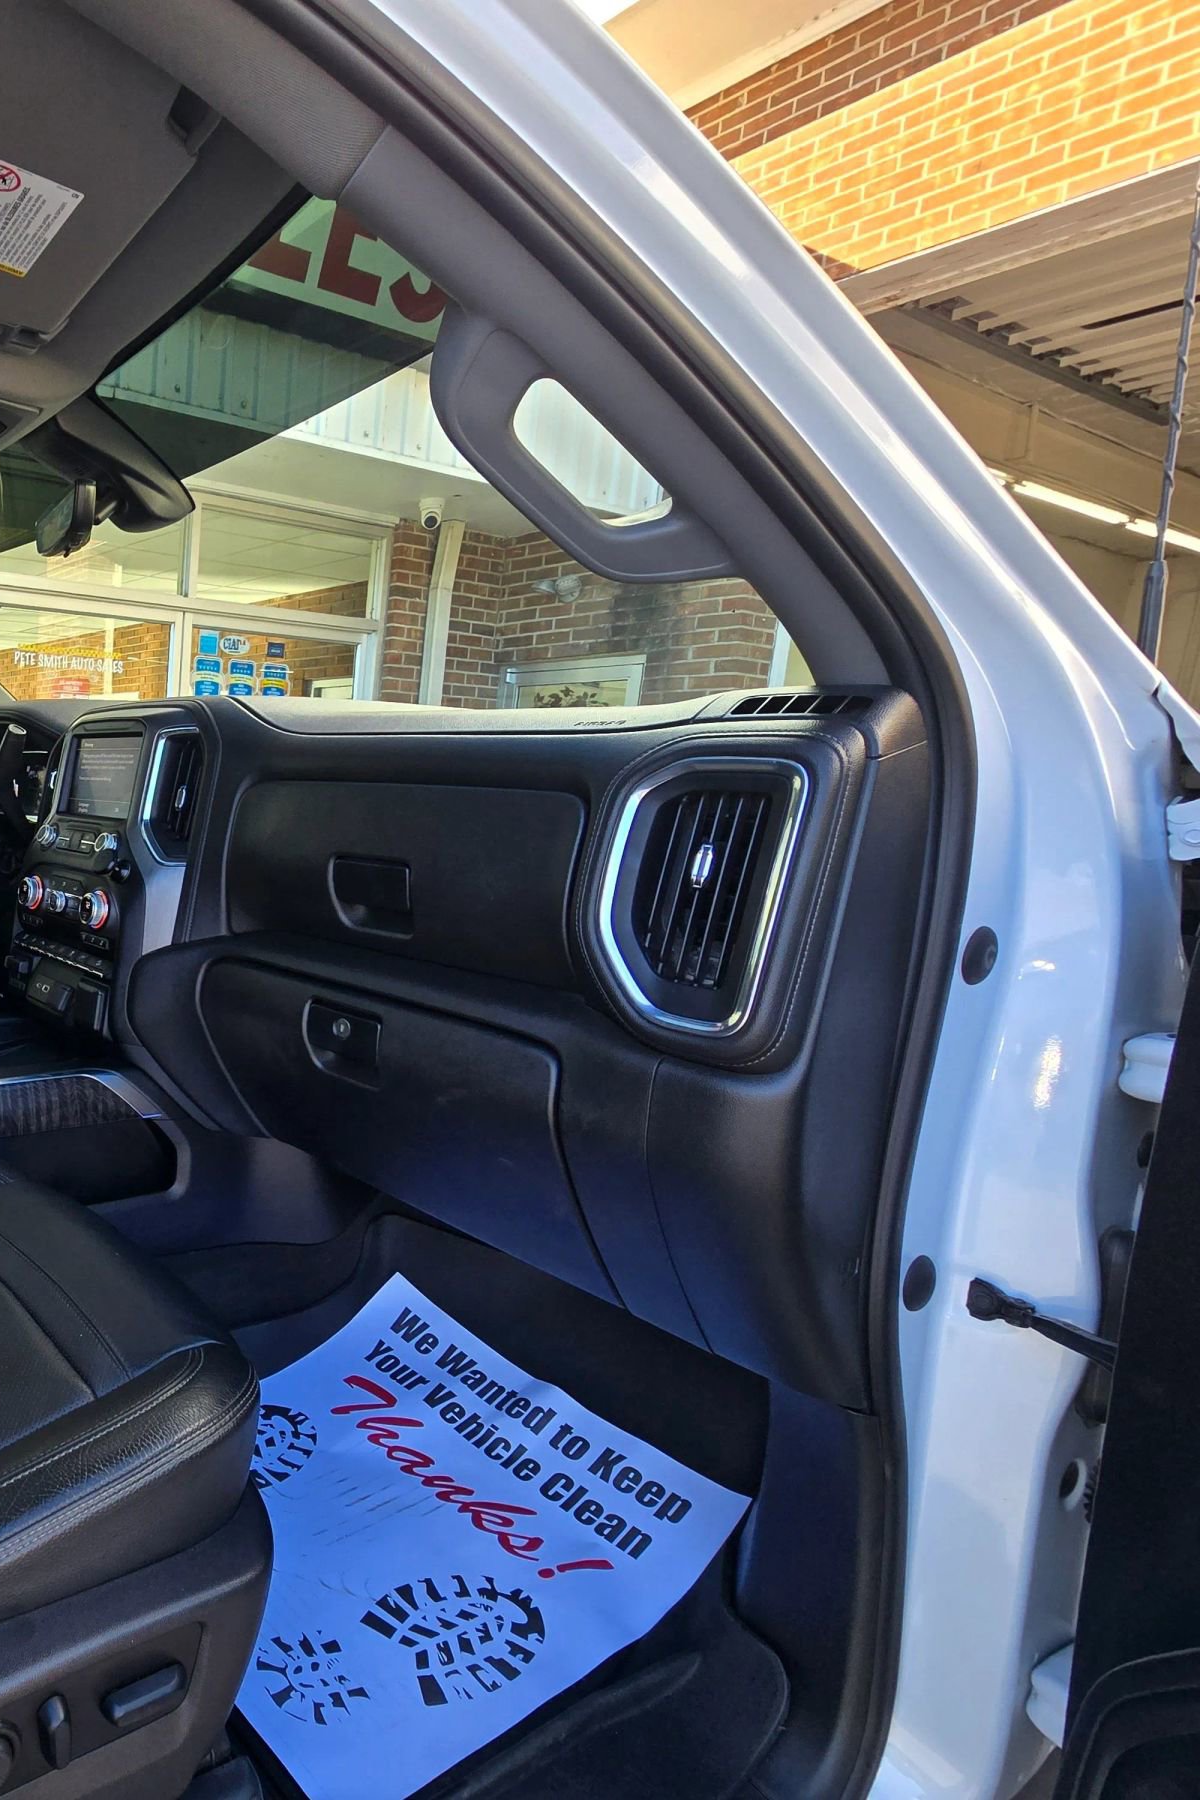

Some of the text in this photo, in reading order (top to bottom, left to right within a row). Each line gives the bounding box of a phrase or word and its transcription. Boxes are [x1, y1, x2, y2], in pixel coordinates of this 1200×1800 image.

[14, 651, 123, 674] PETE SMITH AUTO SAES
[330, 1375, 615, 1579] Thanks!
[364, 1338, 653, 1560] Your Vehicle Clean
[390, 1306, 693, 1524] We Wanted to Keep
